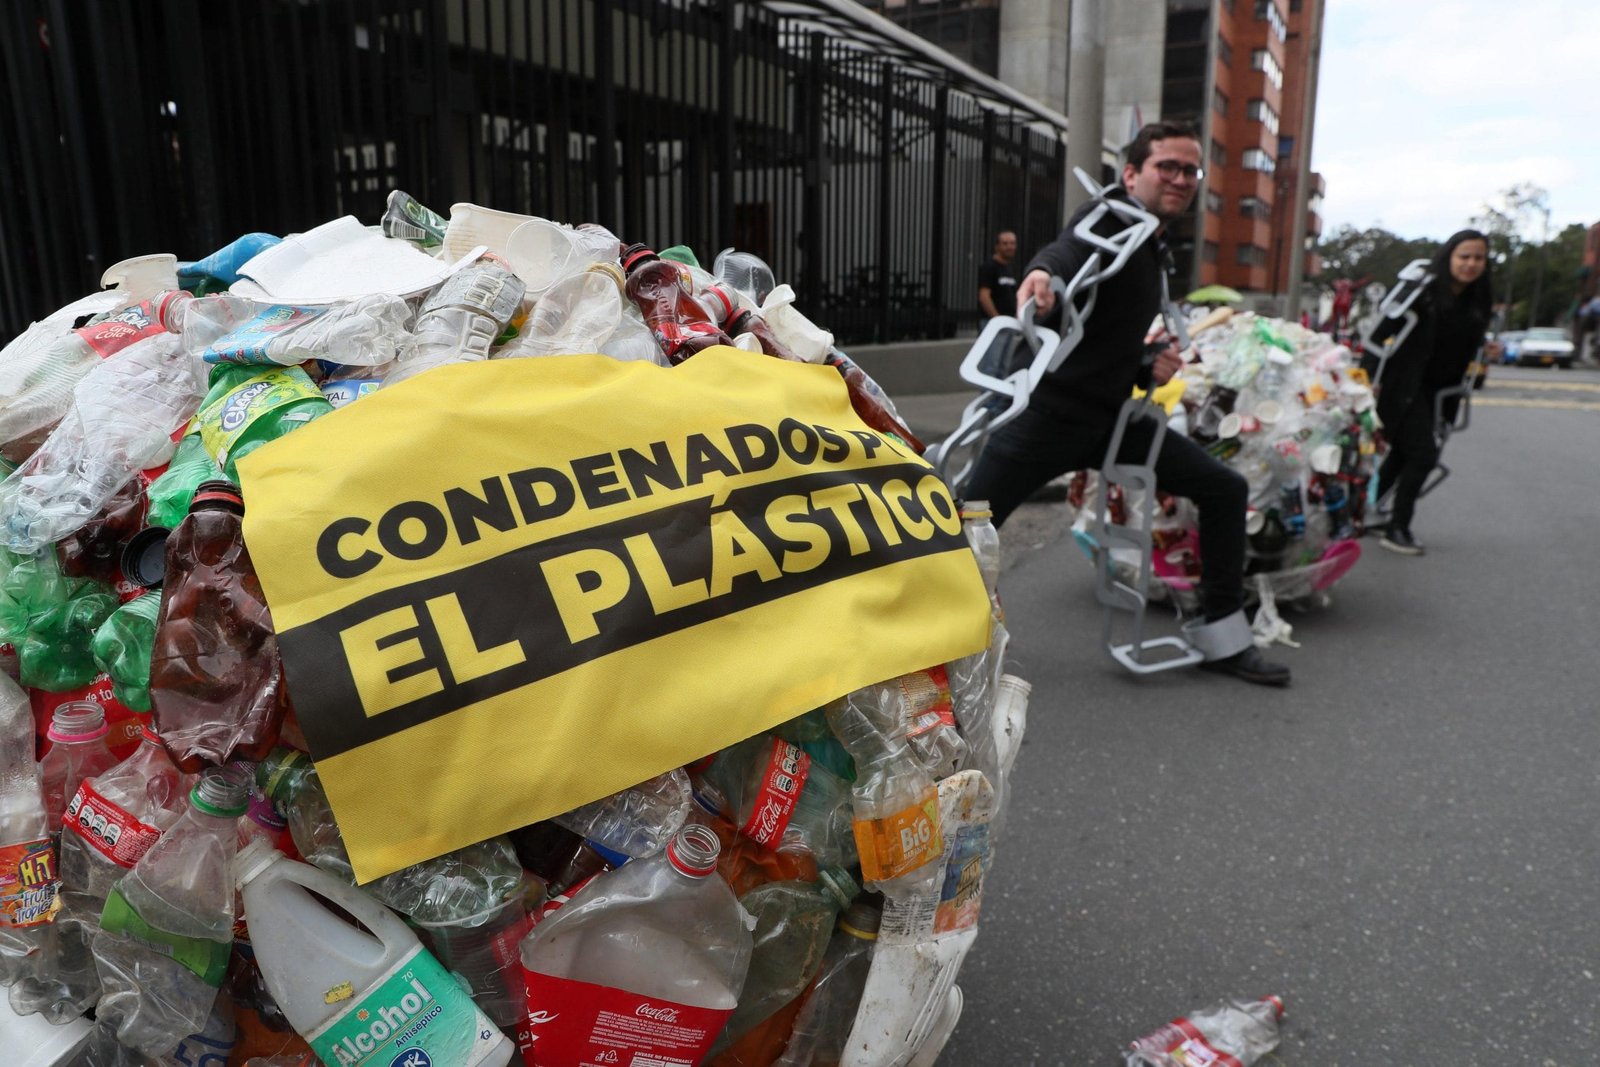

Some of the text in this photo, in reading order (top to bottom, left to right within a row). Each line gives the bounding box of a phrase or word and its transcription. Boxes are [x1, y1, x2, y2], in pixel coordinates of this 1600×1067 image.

[95, 330, 126, 340] Cola
[109, 325, 137, 337] Gran
[326, 390, 350, 401] TAL
[315, 417, 851, 579] CONDENADOS
[339, 474, 962, 718] EL PLÁSTICO
[99, 688, 115, 701] to
[125, 723, 145, 738] Ca
[635, 1003, 678, 1022] Coca-Cola
[331, 978, 433, 1067] Alcohol
[395, 1004, 443, 1048] Antiséptico
